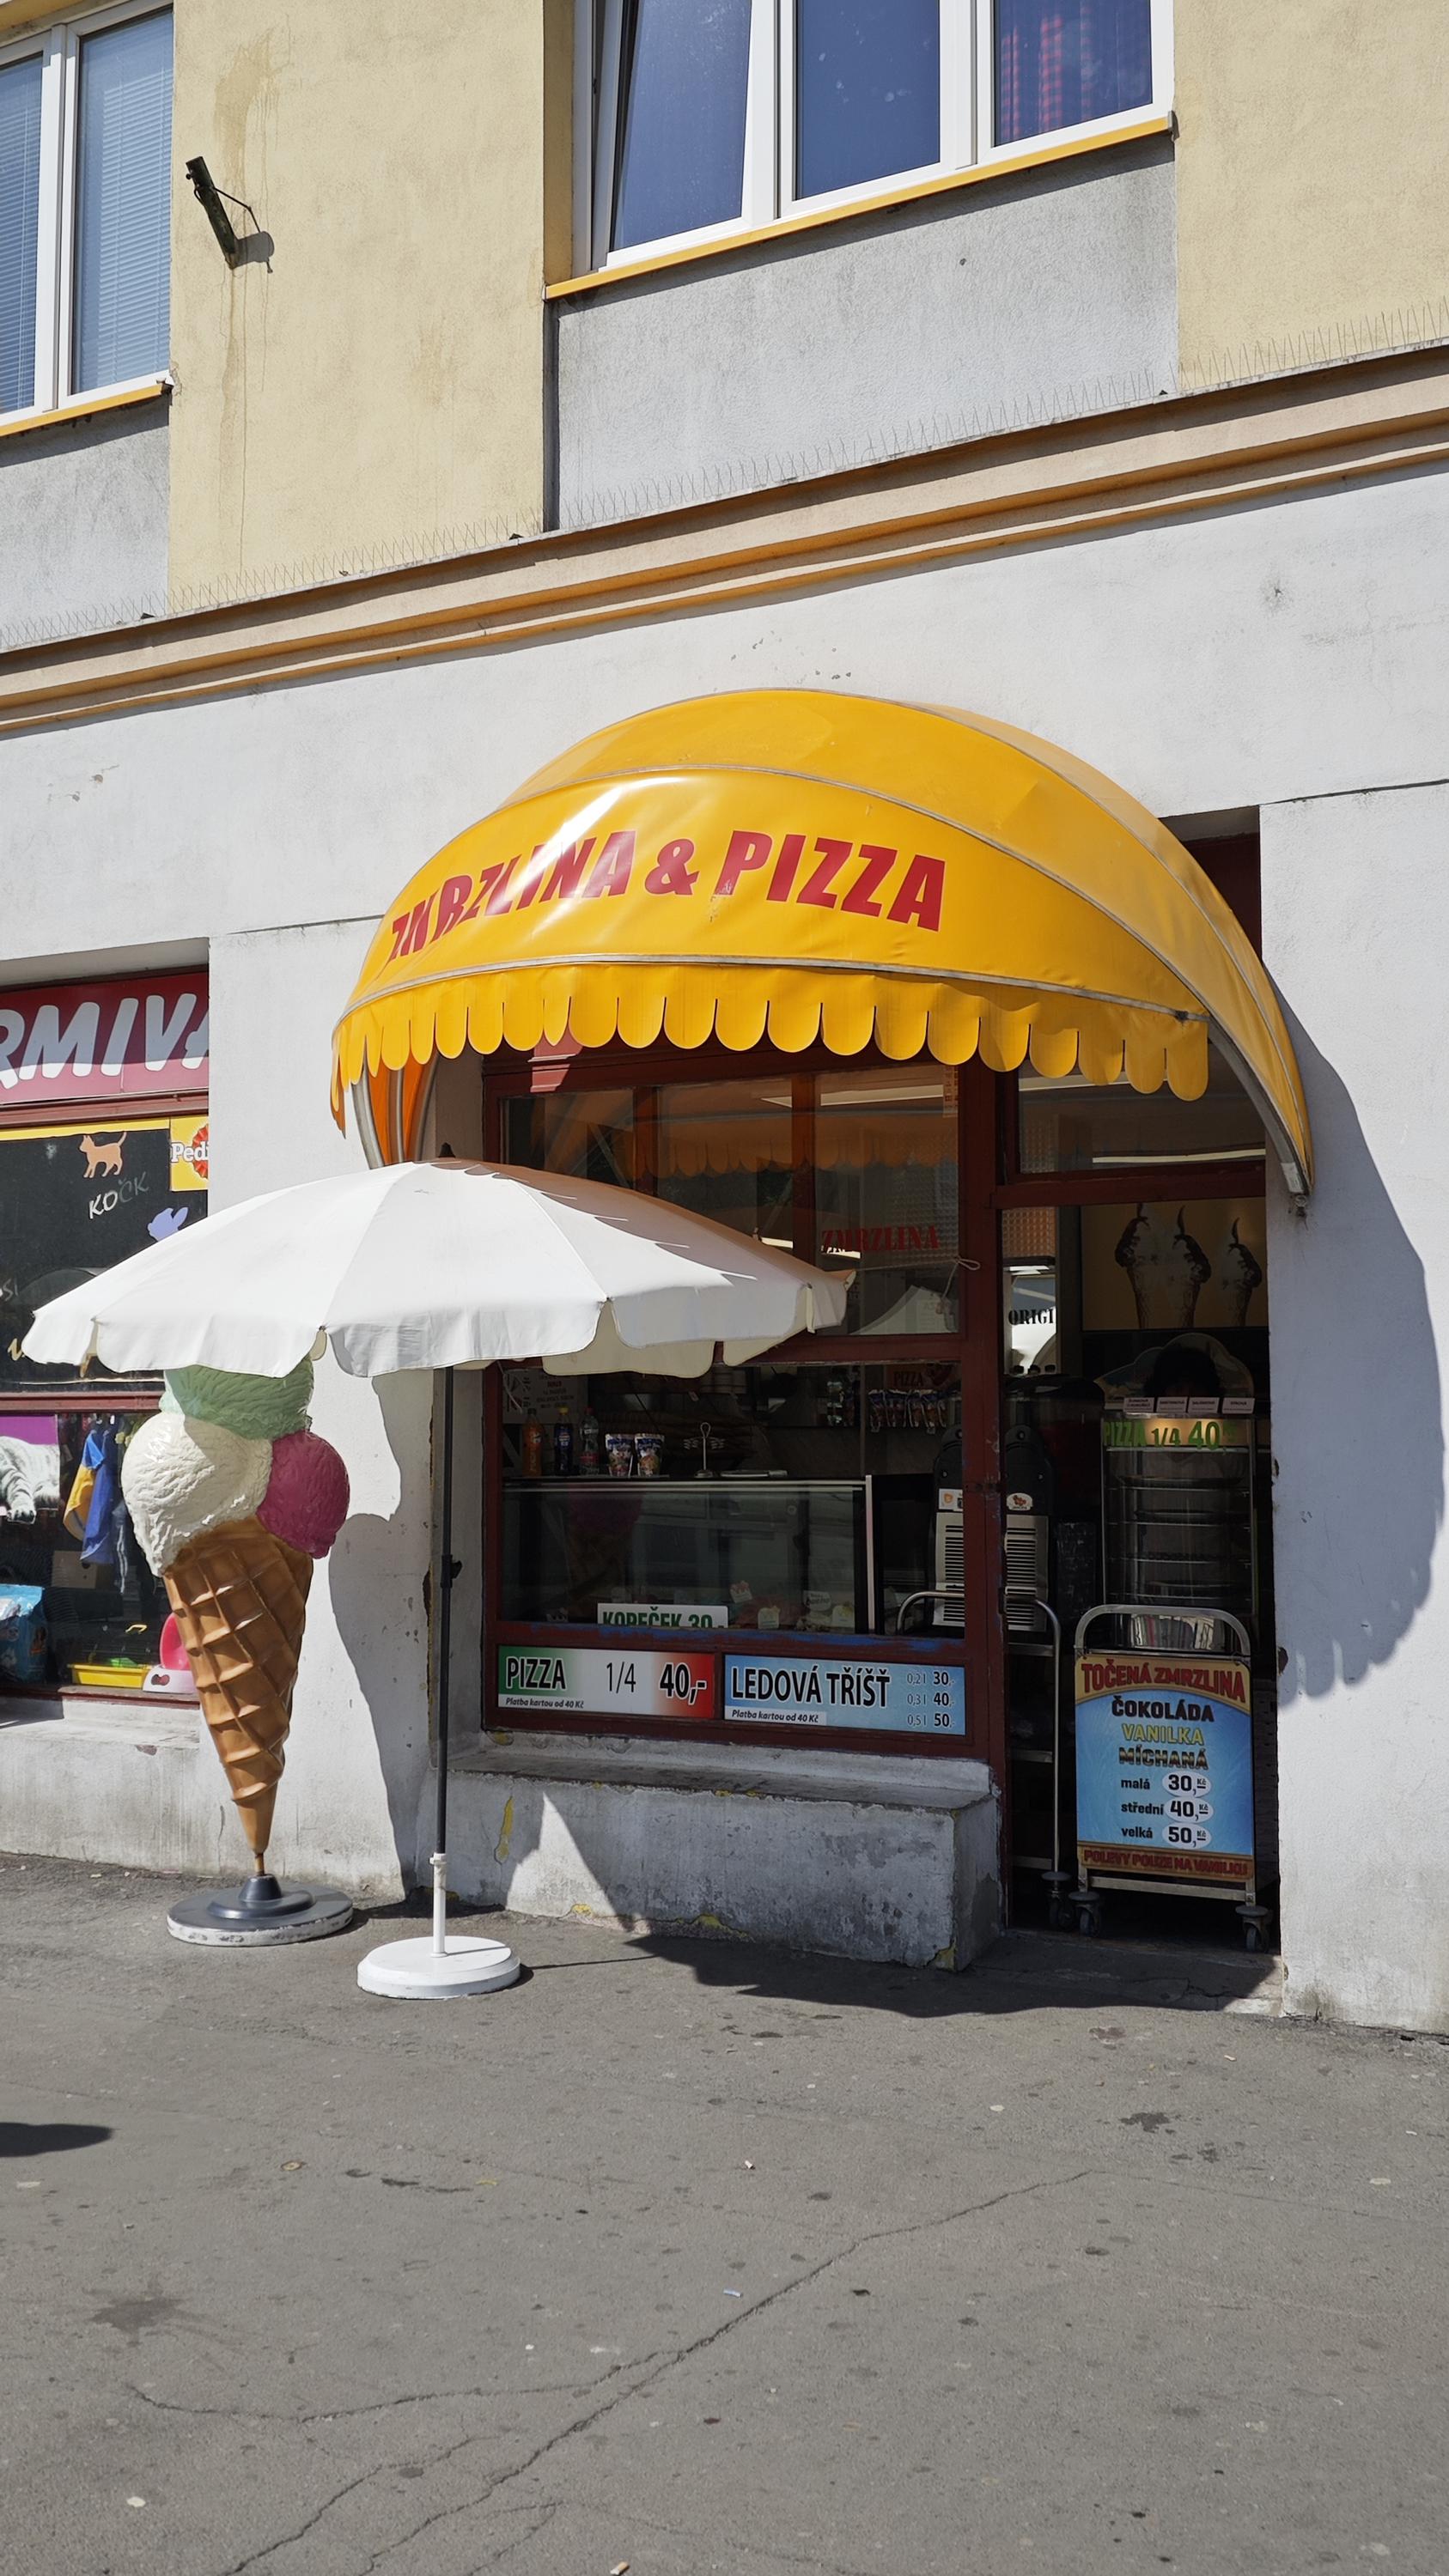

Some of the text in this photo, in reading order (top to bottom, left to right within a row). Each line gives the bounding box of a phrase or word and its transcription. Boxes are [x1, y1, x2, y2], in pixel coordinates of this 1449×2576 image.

[644, 838, 699, 896] &
[713, 830, 946, 933] PIZZA
[821, 1225, 940, 1252] ZMRZLINA
[1103, 1421, 1147, 1447] PIZZA
[1151, 1427, 1181, 1448] 1/4
[507, 1657, 707, 1704] PIZZA 1/4 40,-
[732, 1665, 891, 1707] LEDOVÁ TŘÍŠŤ
[1081, 1659, 1245, 1703] TOČENÁ ZMRZLINA
[505, 1697, 584, 1709] Platba kartou od 40 Kč
[732, 1709, 819, 1723] Platba kartou od 40 Kč
[1111, 1695, 1215, 1722] ČOKOLÁDA
[1122, 1723, 1204, 1746] VANILKA
[1119, 1744, 1209, 1770] MÍCHANÁ
[1121, 1778, 1151, 1790] malá
[1121, 1801, 1165, 1815] střední
[1121, 1826, 1154, 1839] velká
[1174, 1856, 1192, 1870] NA
